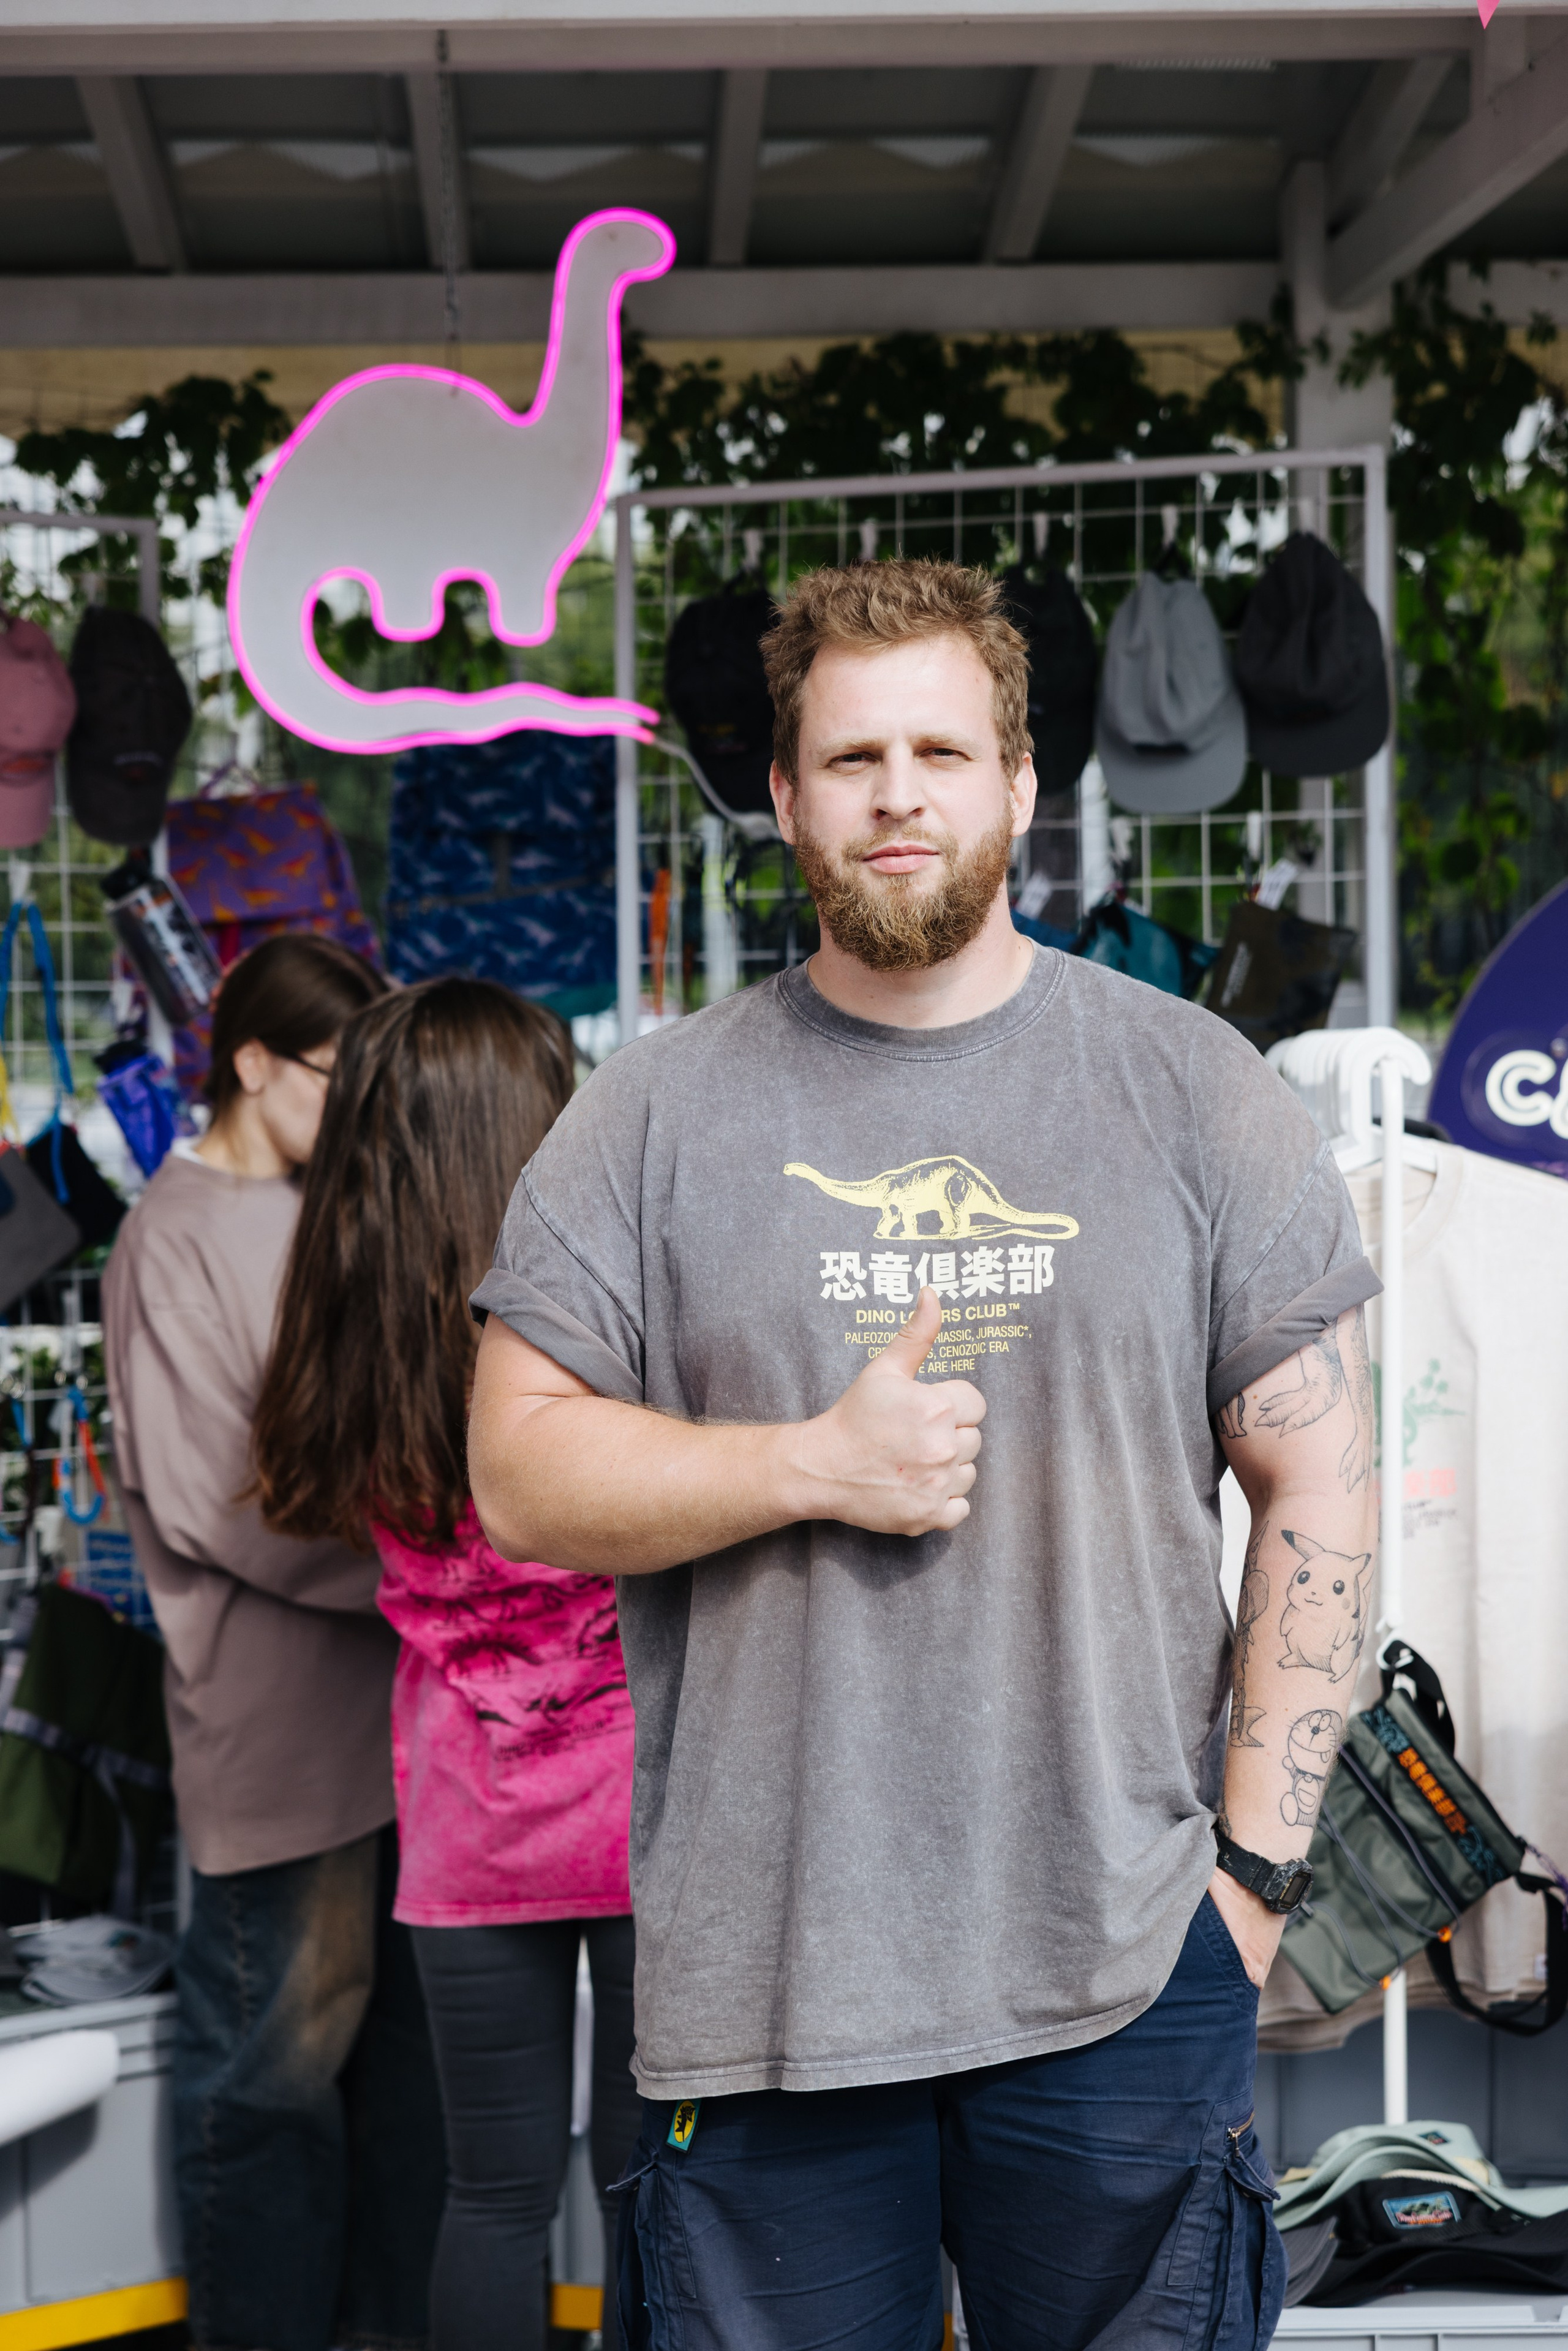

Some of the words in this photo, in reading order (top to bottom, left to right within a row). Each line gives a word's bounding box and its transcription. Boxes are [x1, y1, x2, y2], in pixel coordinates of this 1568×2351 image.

[820, 1243, 1055, 1304] 恐竜倶楽部
[856, 1310, 895, 1324] DINO
[934, 1329, 974, 1343] RIASSIC,
[939, 1342, 986, 1358] CENOZOIC
[989, 1341, 1009, 1353] ERA
[927, 1360, 948, 1373] ARE
[951, 1359, 975, 1372] HERE
